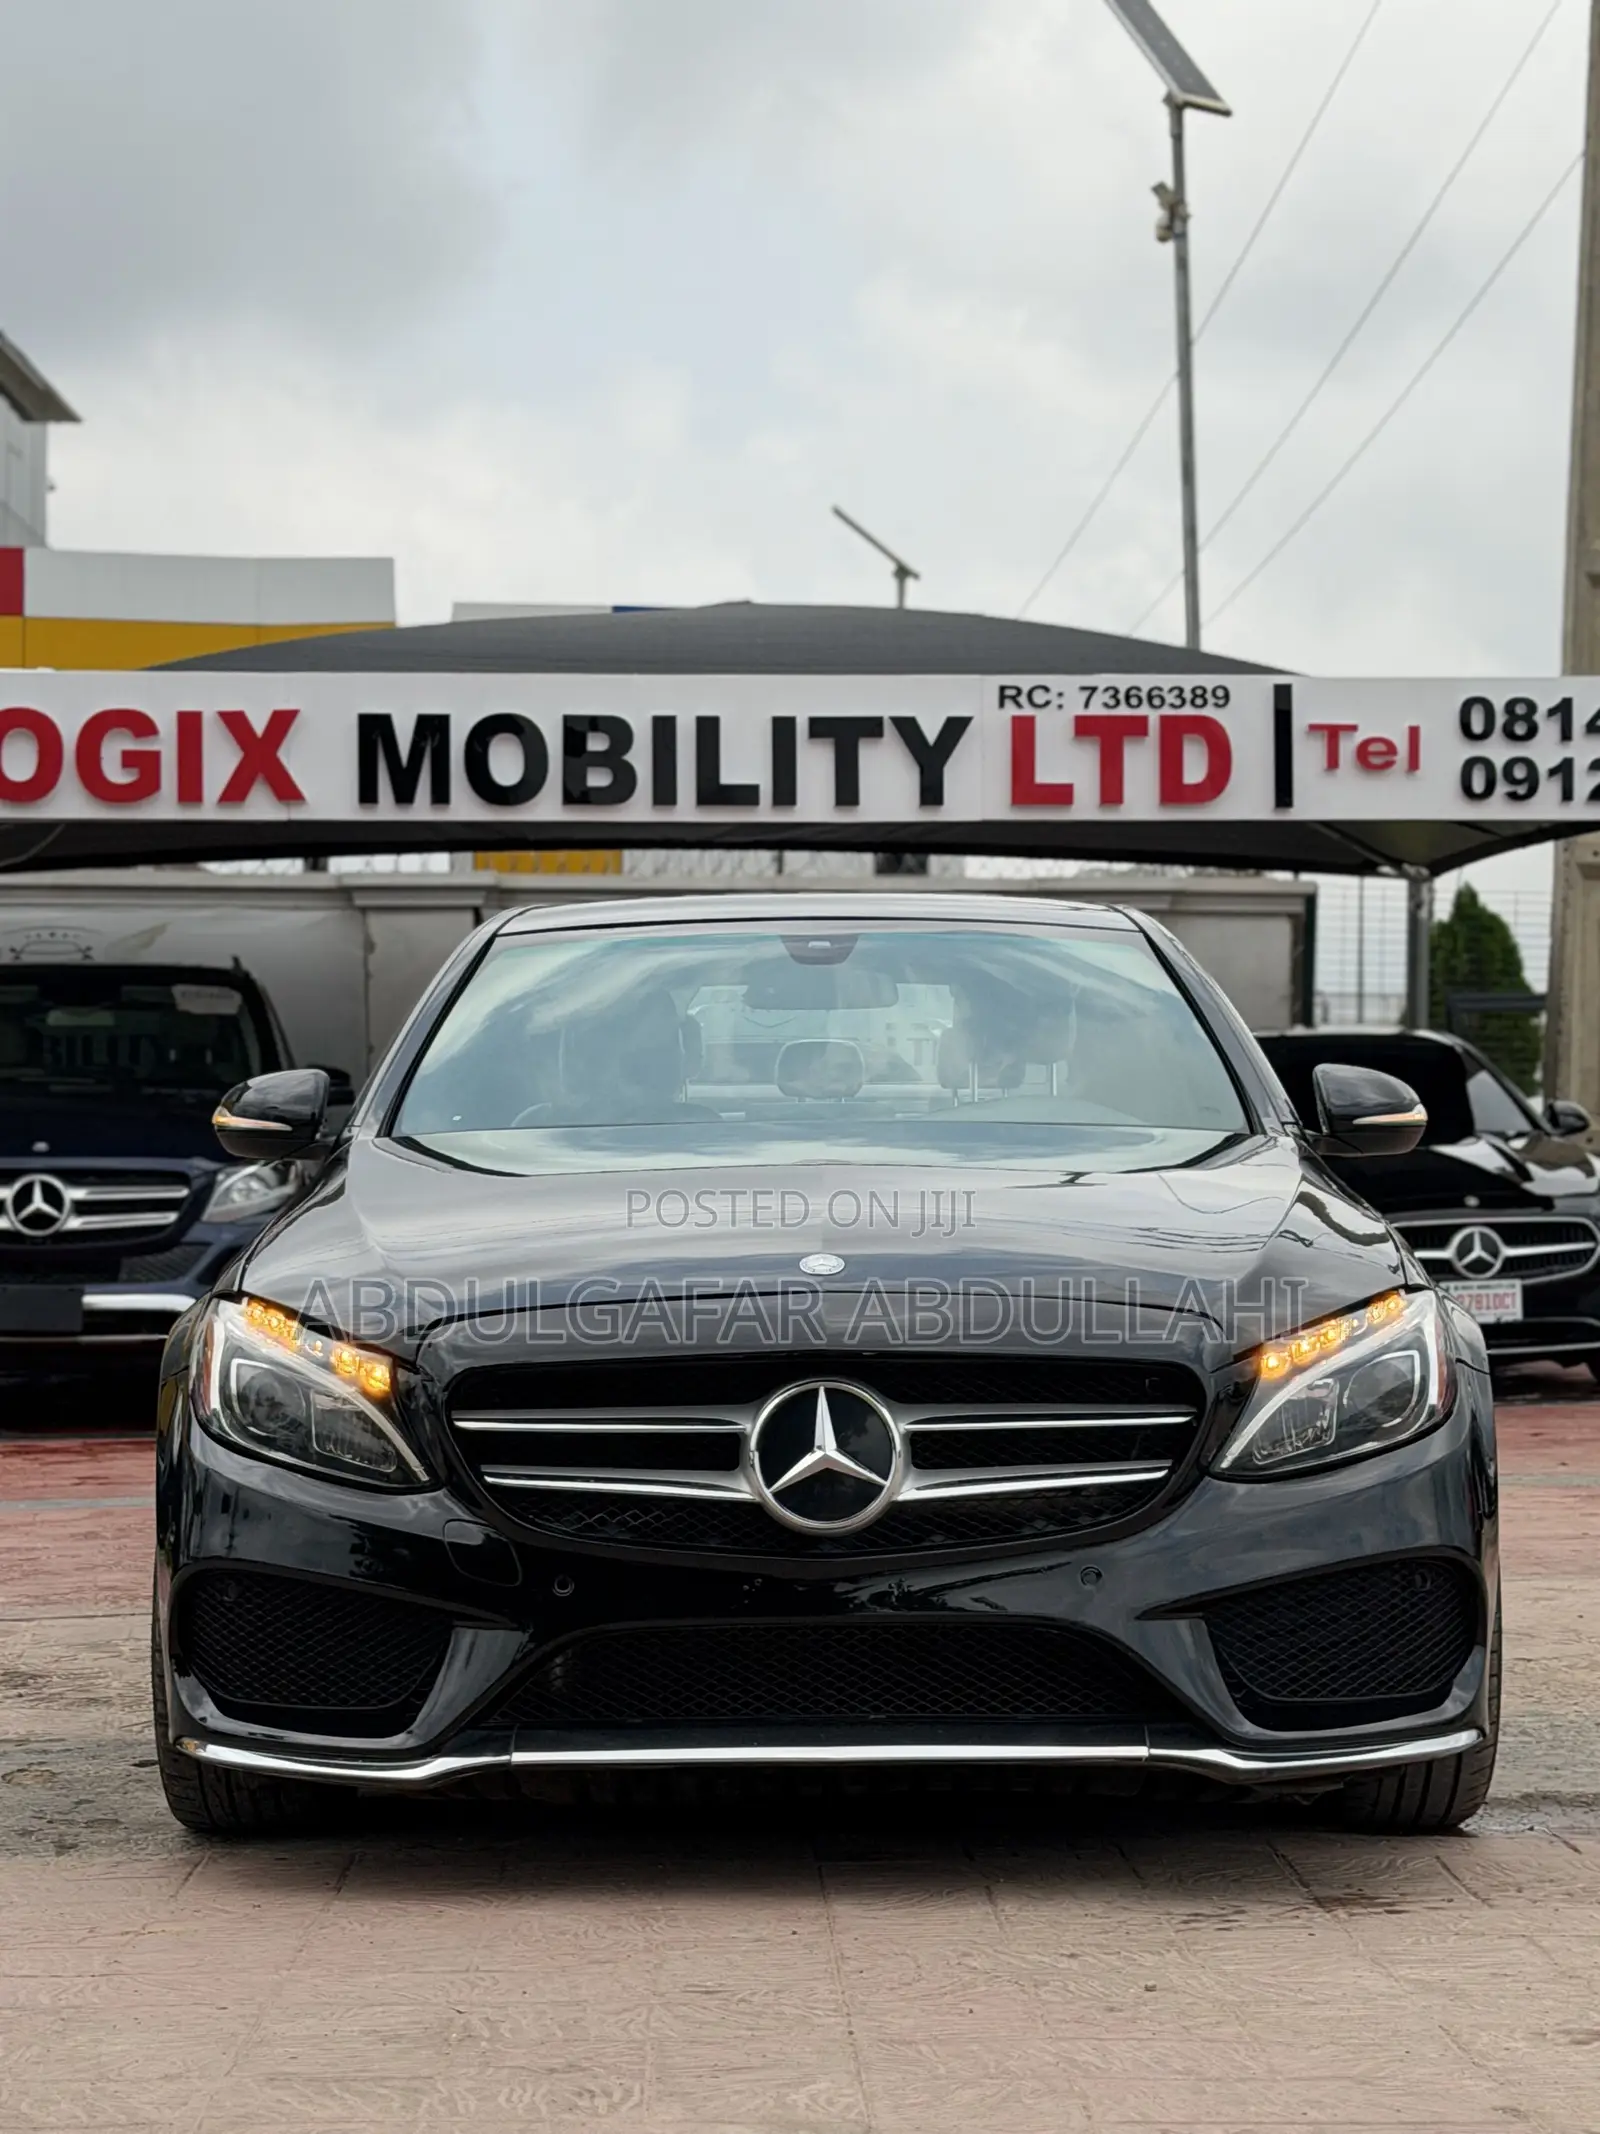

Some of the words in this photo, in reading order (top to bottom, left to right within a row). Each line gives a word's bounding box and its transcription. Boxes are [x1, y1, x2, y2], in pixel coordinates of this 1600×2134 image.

[998, 685, 1064, 709] RC:
[1078, 685, 1231, 710] 7366389
[0, 707, 306, 805] OGIX
[357, 712, 974, 807] MOBILITY
[1011, 714, 1232, 806] LTD
[1307, 723, 1421, 772] Tel
